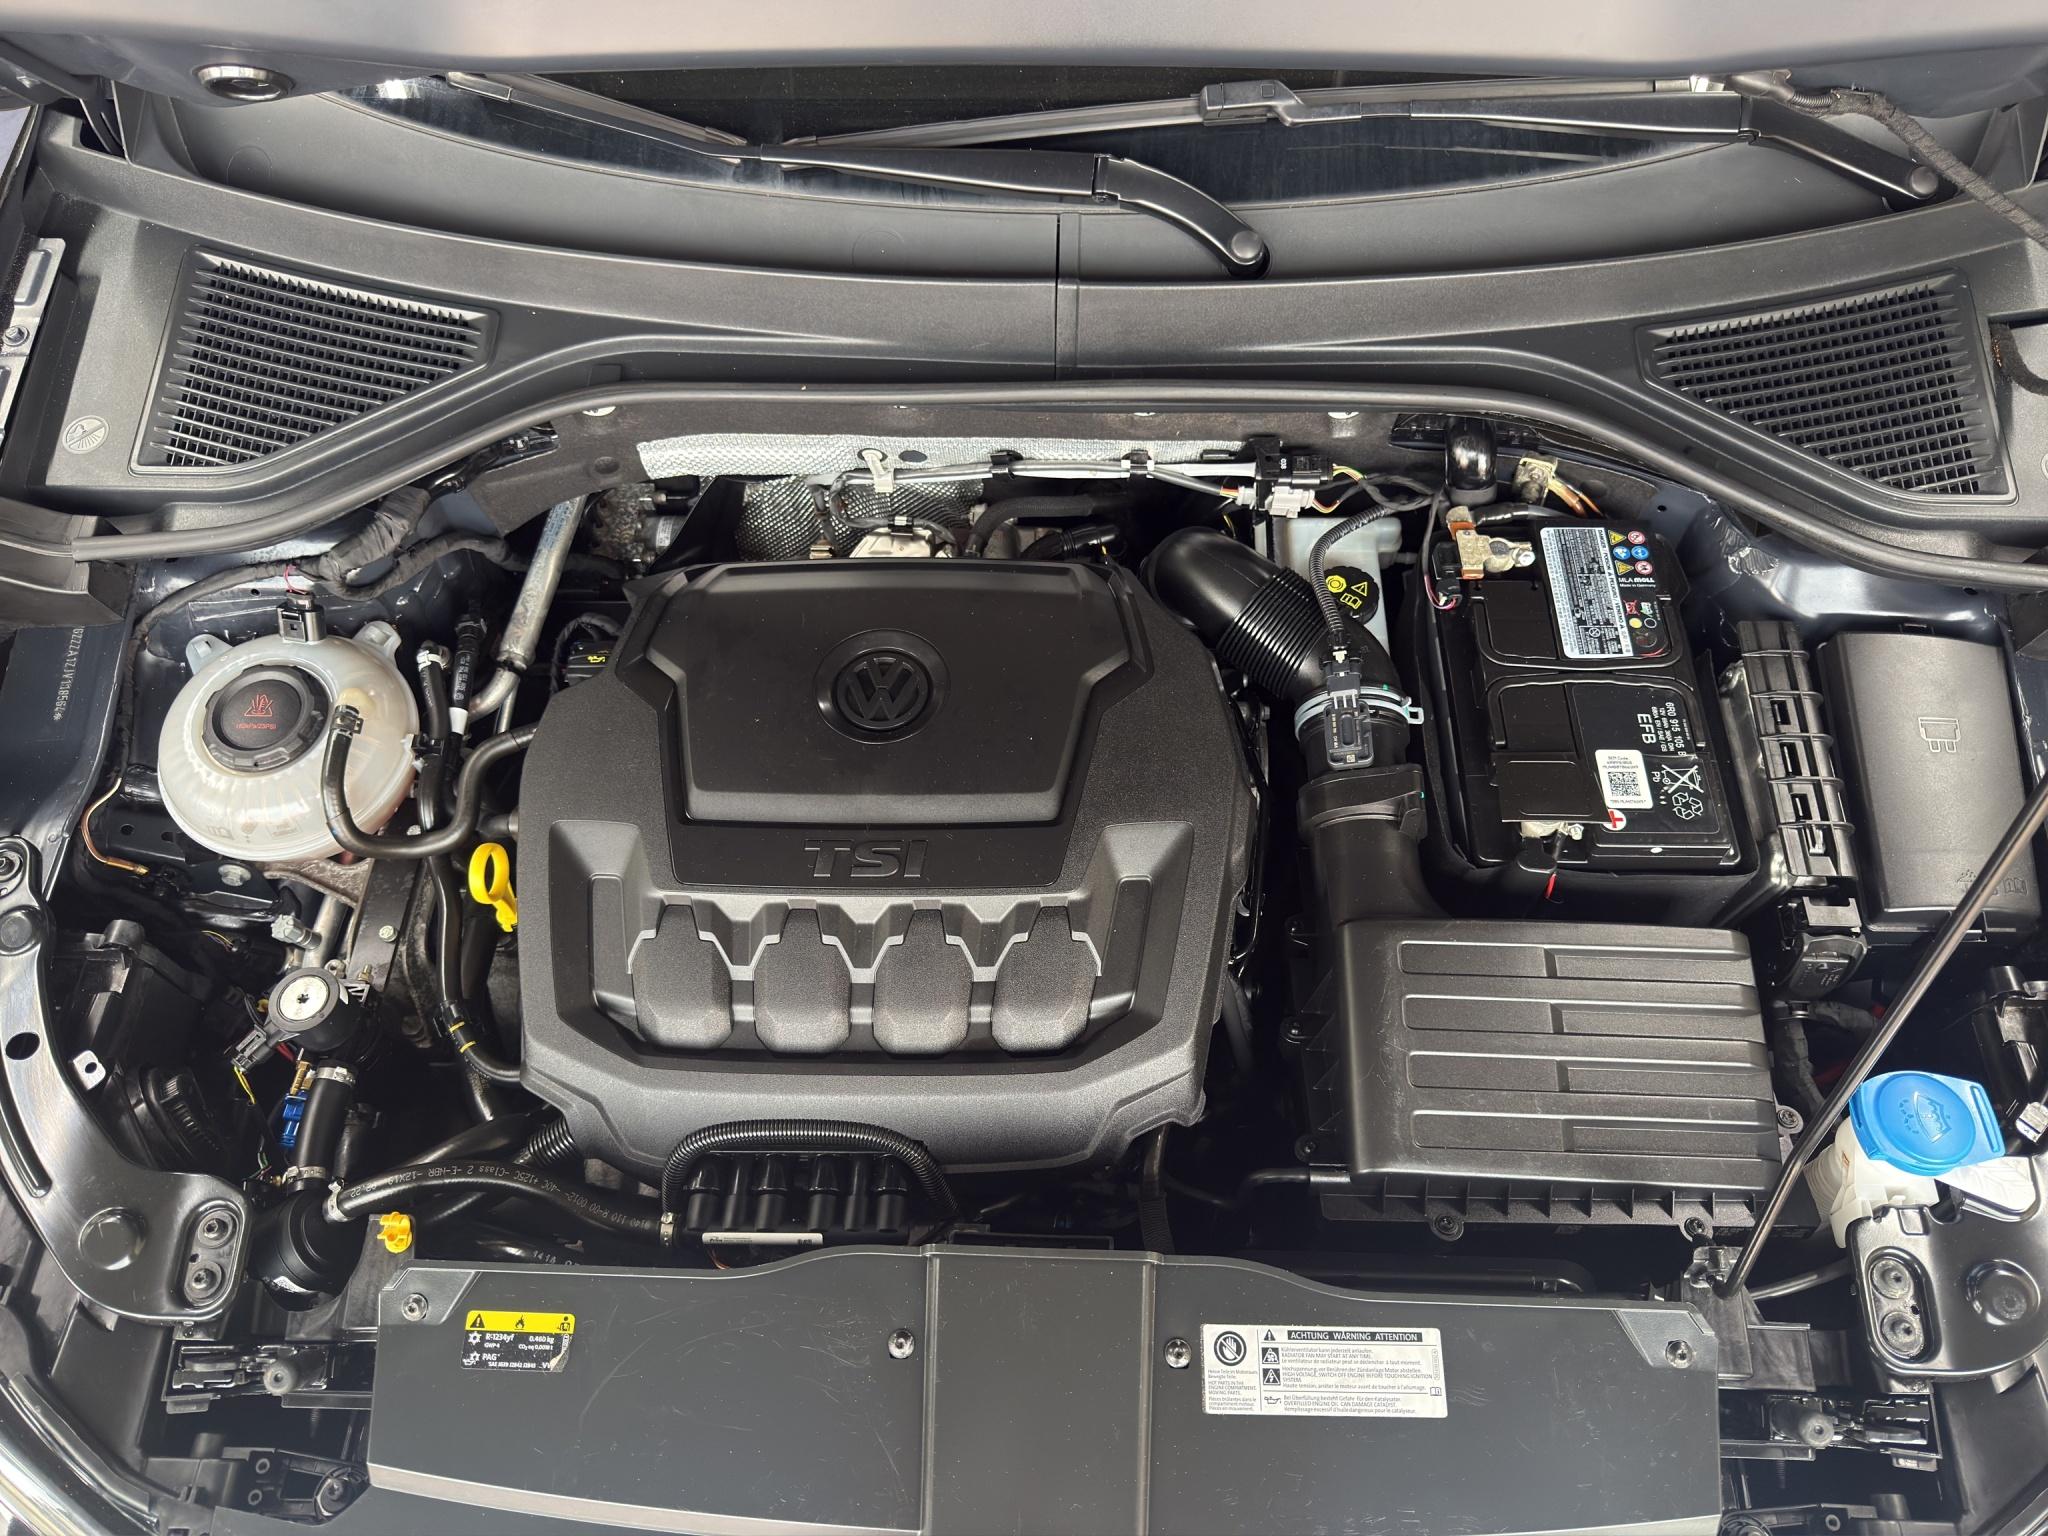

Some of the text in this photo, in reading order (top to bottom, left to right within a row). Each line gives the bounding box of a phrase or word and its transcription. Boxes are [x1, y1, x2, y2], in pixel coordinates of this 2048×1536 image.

[1665, 702, 1676, 717] 6R0
[1637, 713, 1656, 744] EFB
[1670, 719, 1680, 732] 915
[1674, 736, 1684, 748] 105
[1651, 771, 1660, 782] Pb
[805, 839, 929, 878] TSI
[466, 1165, 474, 1175] 2
[485, 1334, 515, 1342] R-1234yf
[1290, 1331, 1418, 1341] ACHTUNG WARNING ATTENTION
